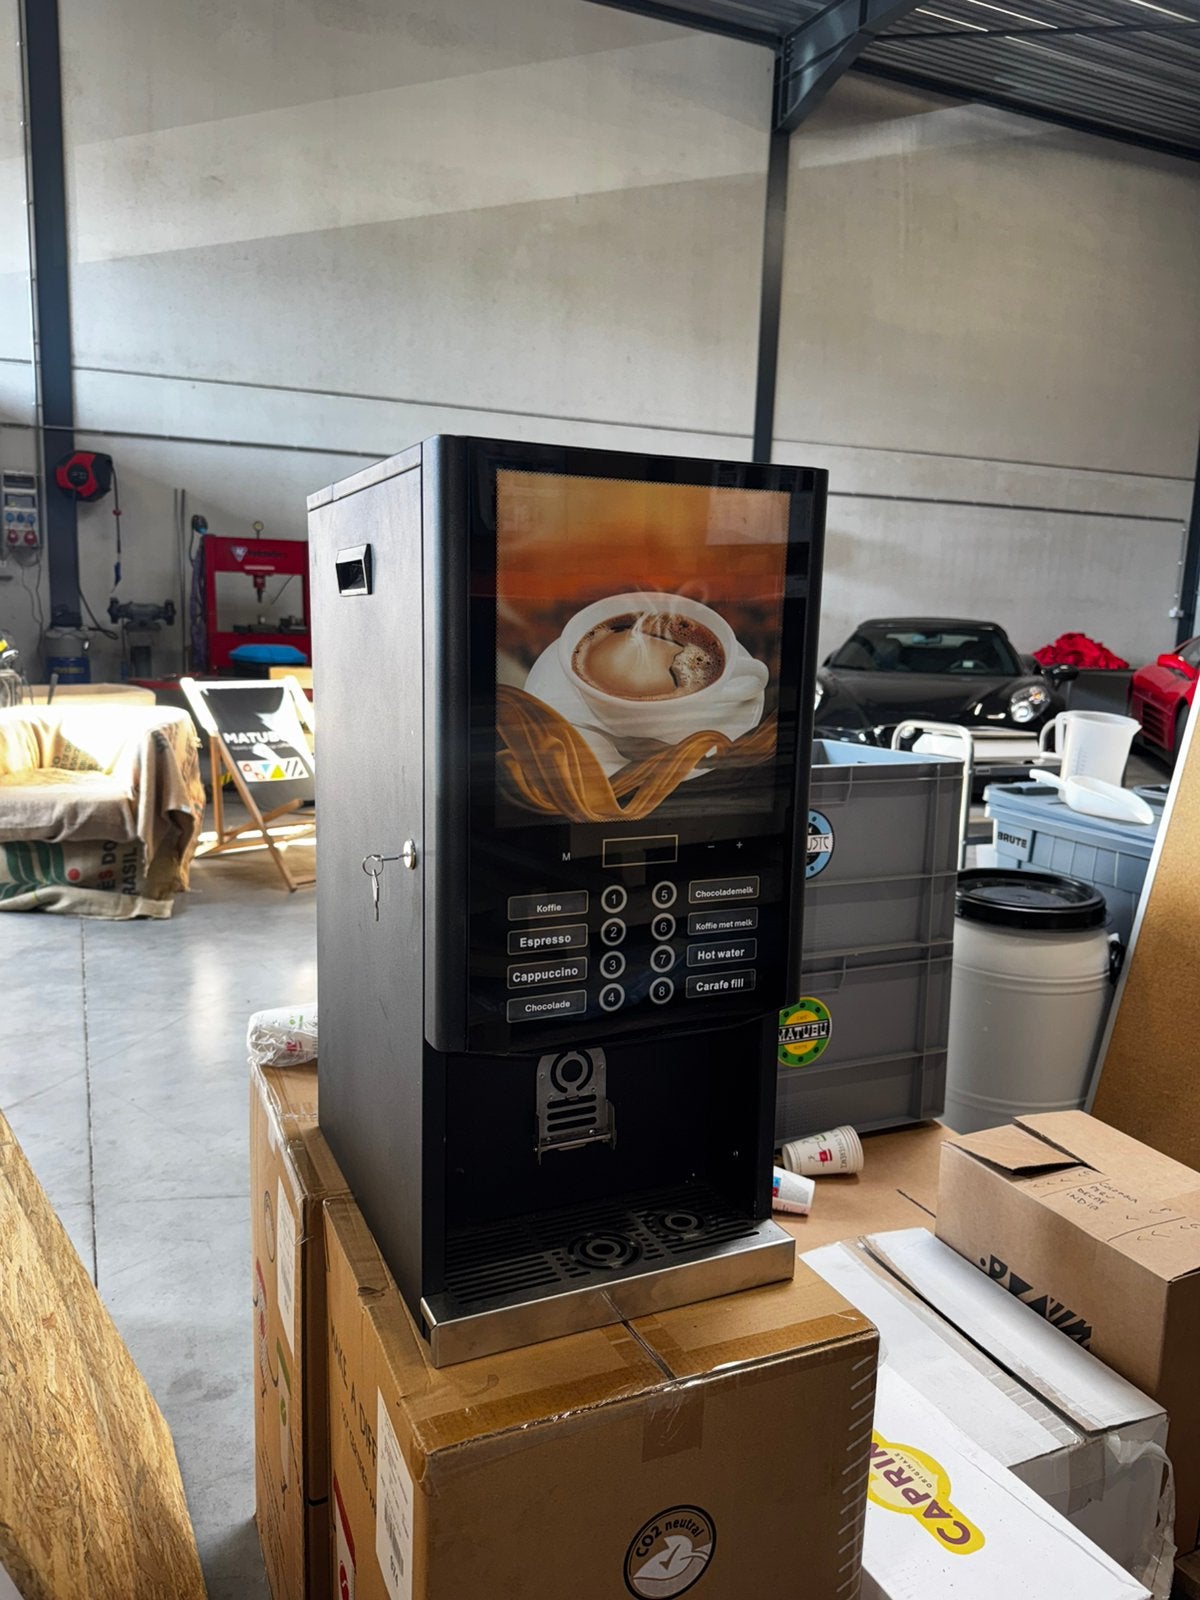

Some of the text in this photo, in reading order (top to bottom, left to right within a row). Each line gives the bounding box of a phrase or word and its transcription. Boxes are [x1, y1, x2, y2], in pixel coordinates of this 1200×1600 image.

[997, 831, 1028, 849] BRUTE
[562, 851, 571, 861] M
[121, 846, 141, 897] RASIL
[660, 889, 669, 901] 5
[695, 885, 754, 899] Chocolademelk
[610, 894, 617, 905] 1
[536, 903, 562, 914] Koffie
[660, 921, 668, 933] 6
[695, 918, 753, 931] Koffie met melk
[610, 926, 618, 938] 2
[519, 934, 572, 949] Espresso
[660, 954, 667, 965] 7
[697, 948, 745, 961] Hot water
[609, 959, 617, 971] 3
[512, 966, 579, 983] Cappuccino
[658, 985, 666, 997] 8
[696, 978, 745, 992] Carafe fill
[607, 992, 616, 1003] 4
[524, 1000, 571, 1013] Chocolade
[894, 1452, 933, 1489] ORIGINALE
[635, 1519, 705, 1558] CO2 neutral
